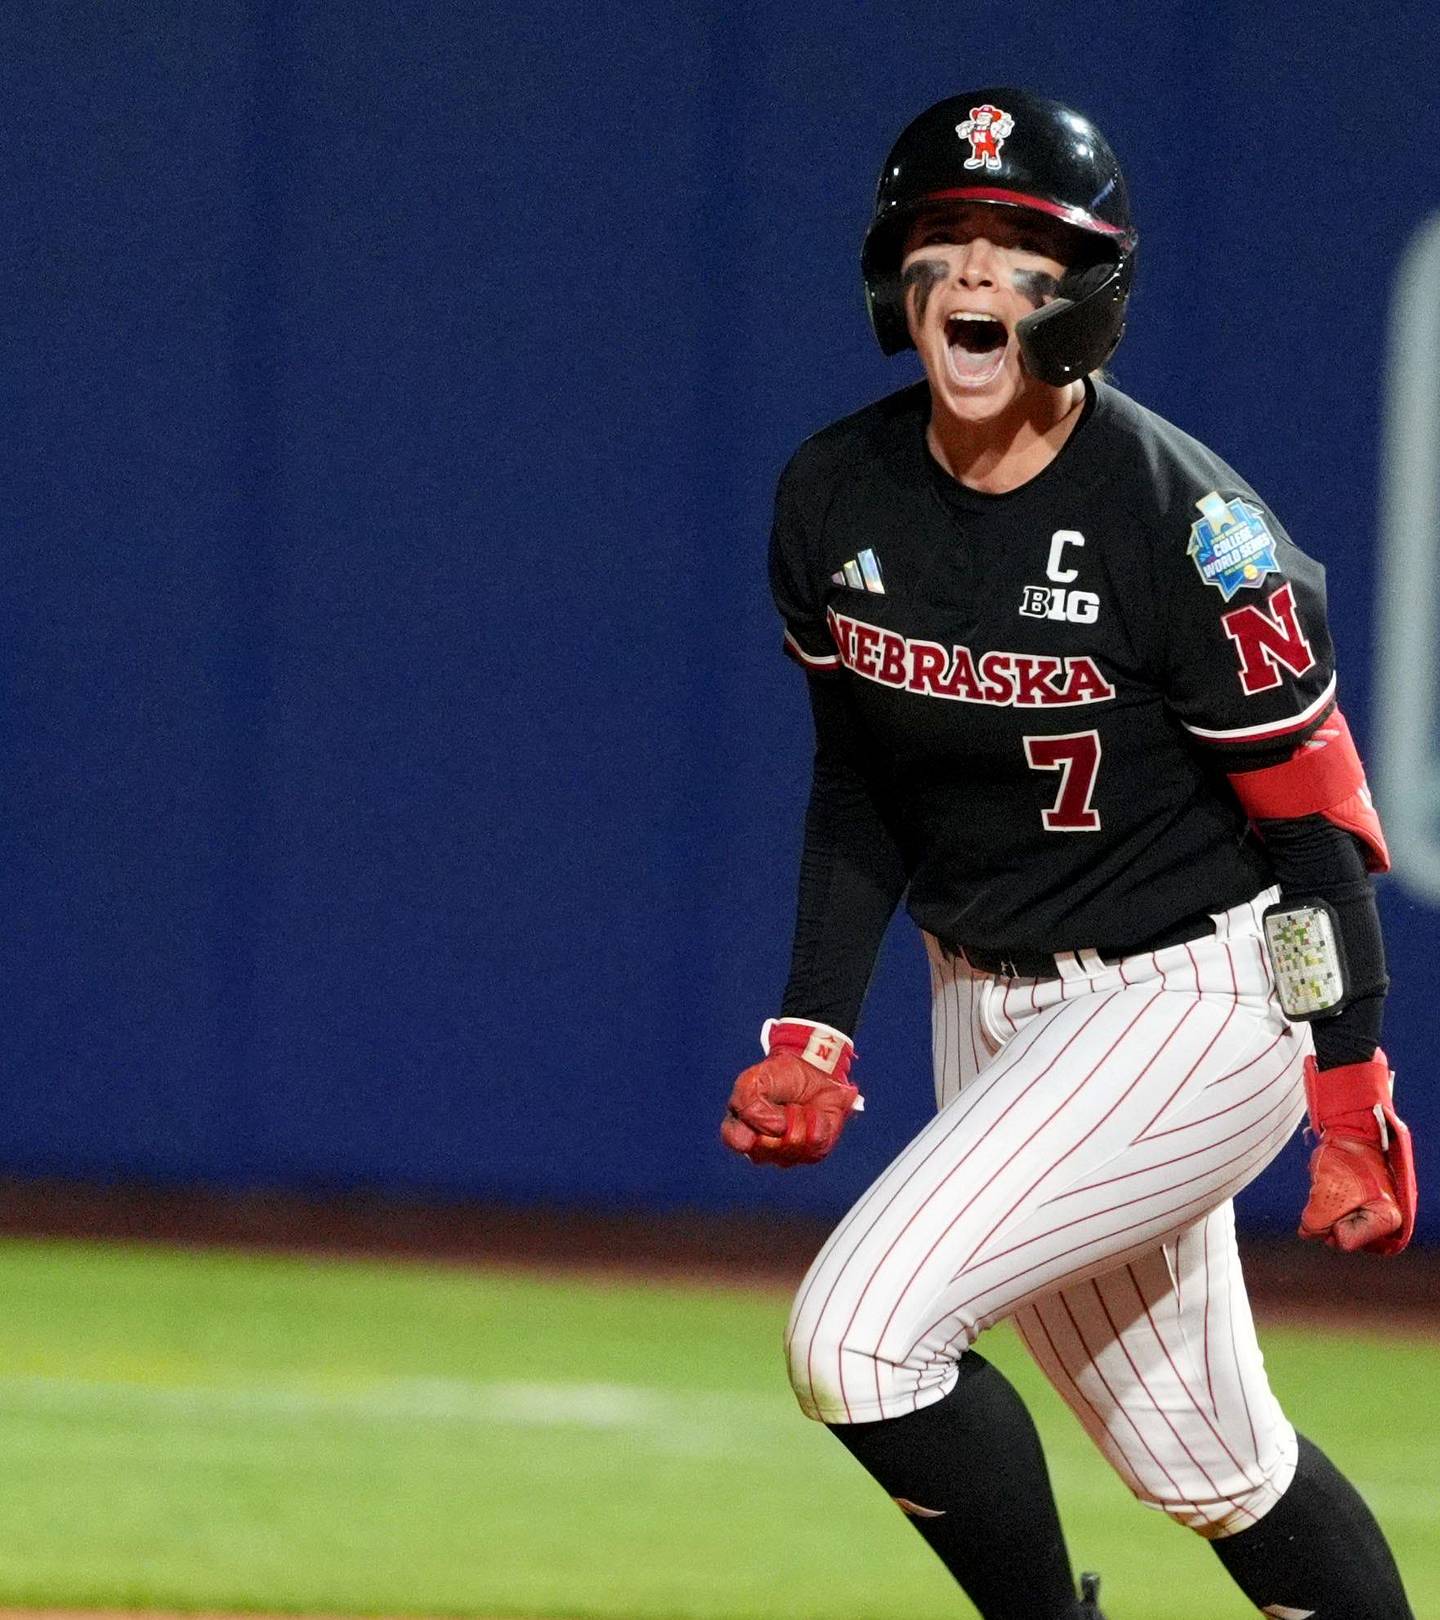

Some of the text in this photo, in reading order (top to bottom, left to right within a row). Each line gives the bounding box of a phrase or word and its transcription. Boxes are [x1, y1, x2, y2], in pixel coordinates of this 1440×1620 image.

[974, 131, 986, 143] N
[1046, 529, 1085, 583] C
[1203, 549, 1242, 578] WORLD
[1241, 532, 1271, 559] SERIES
[1213, 526, 1253, 557] COLLEGE
[827, 605, 1116, 708] NEBRASKA
[1221, 581, 1316, 696] N
[1022, 729, 1101, 831] 7
[816, 1044, 833, 1061] N
